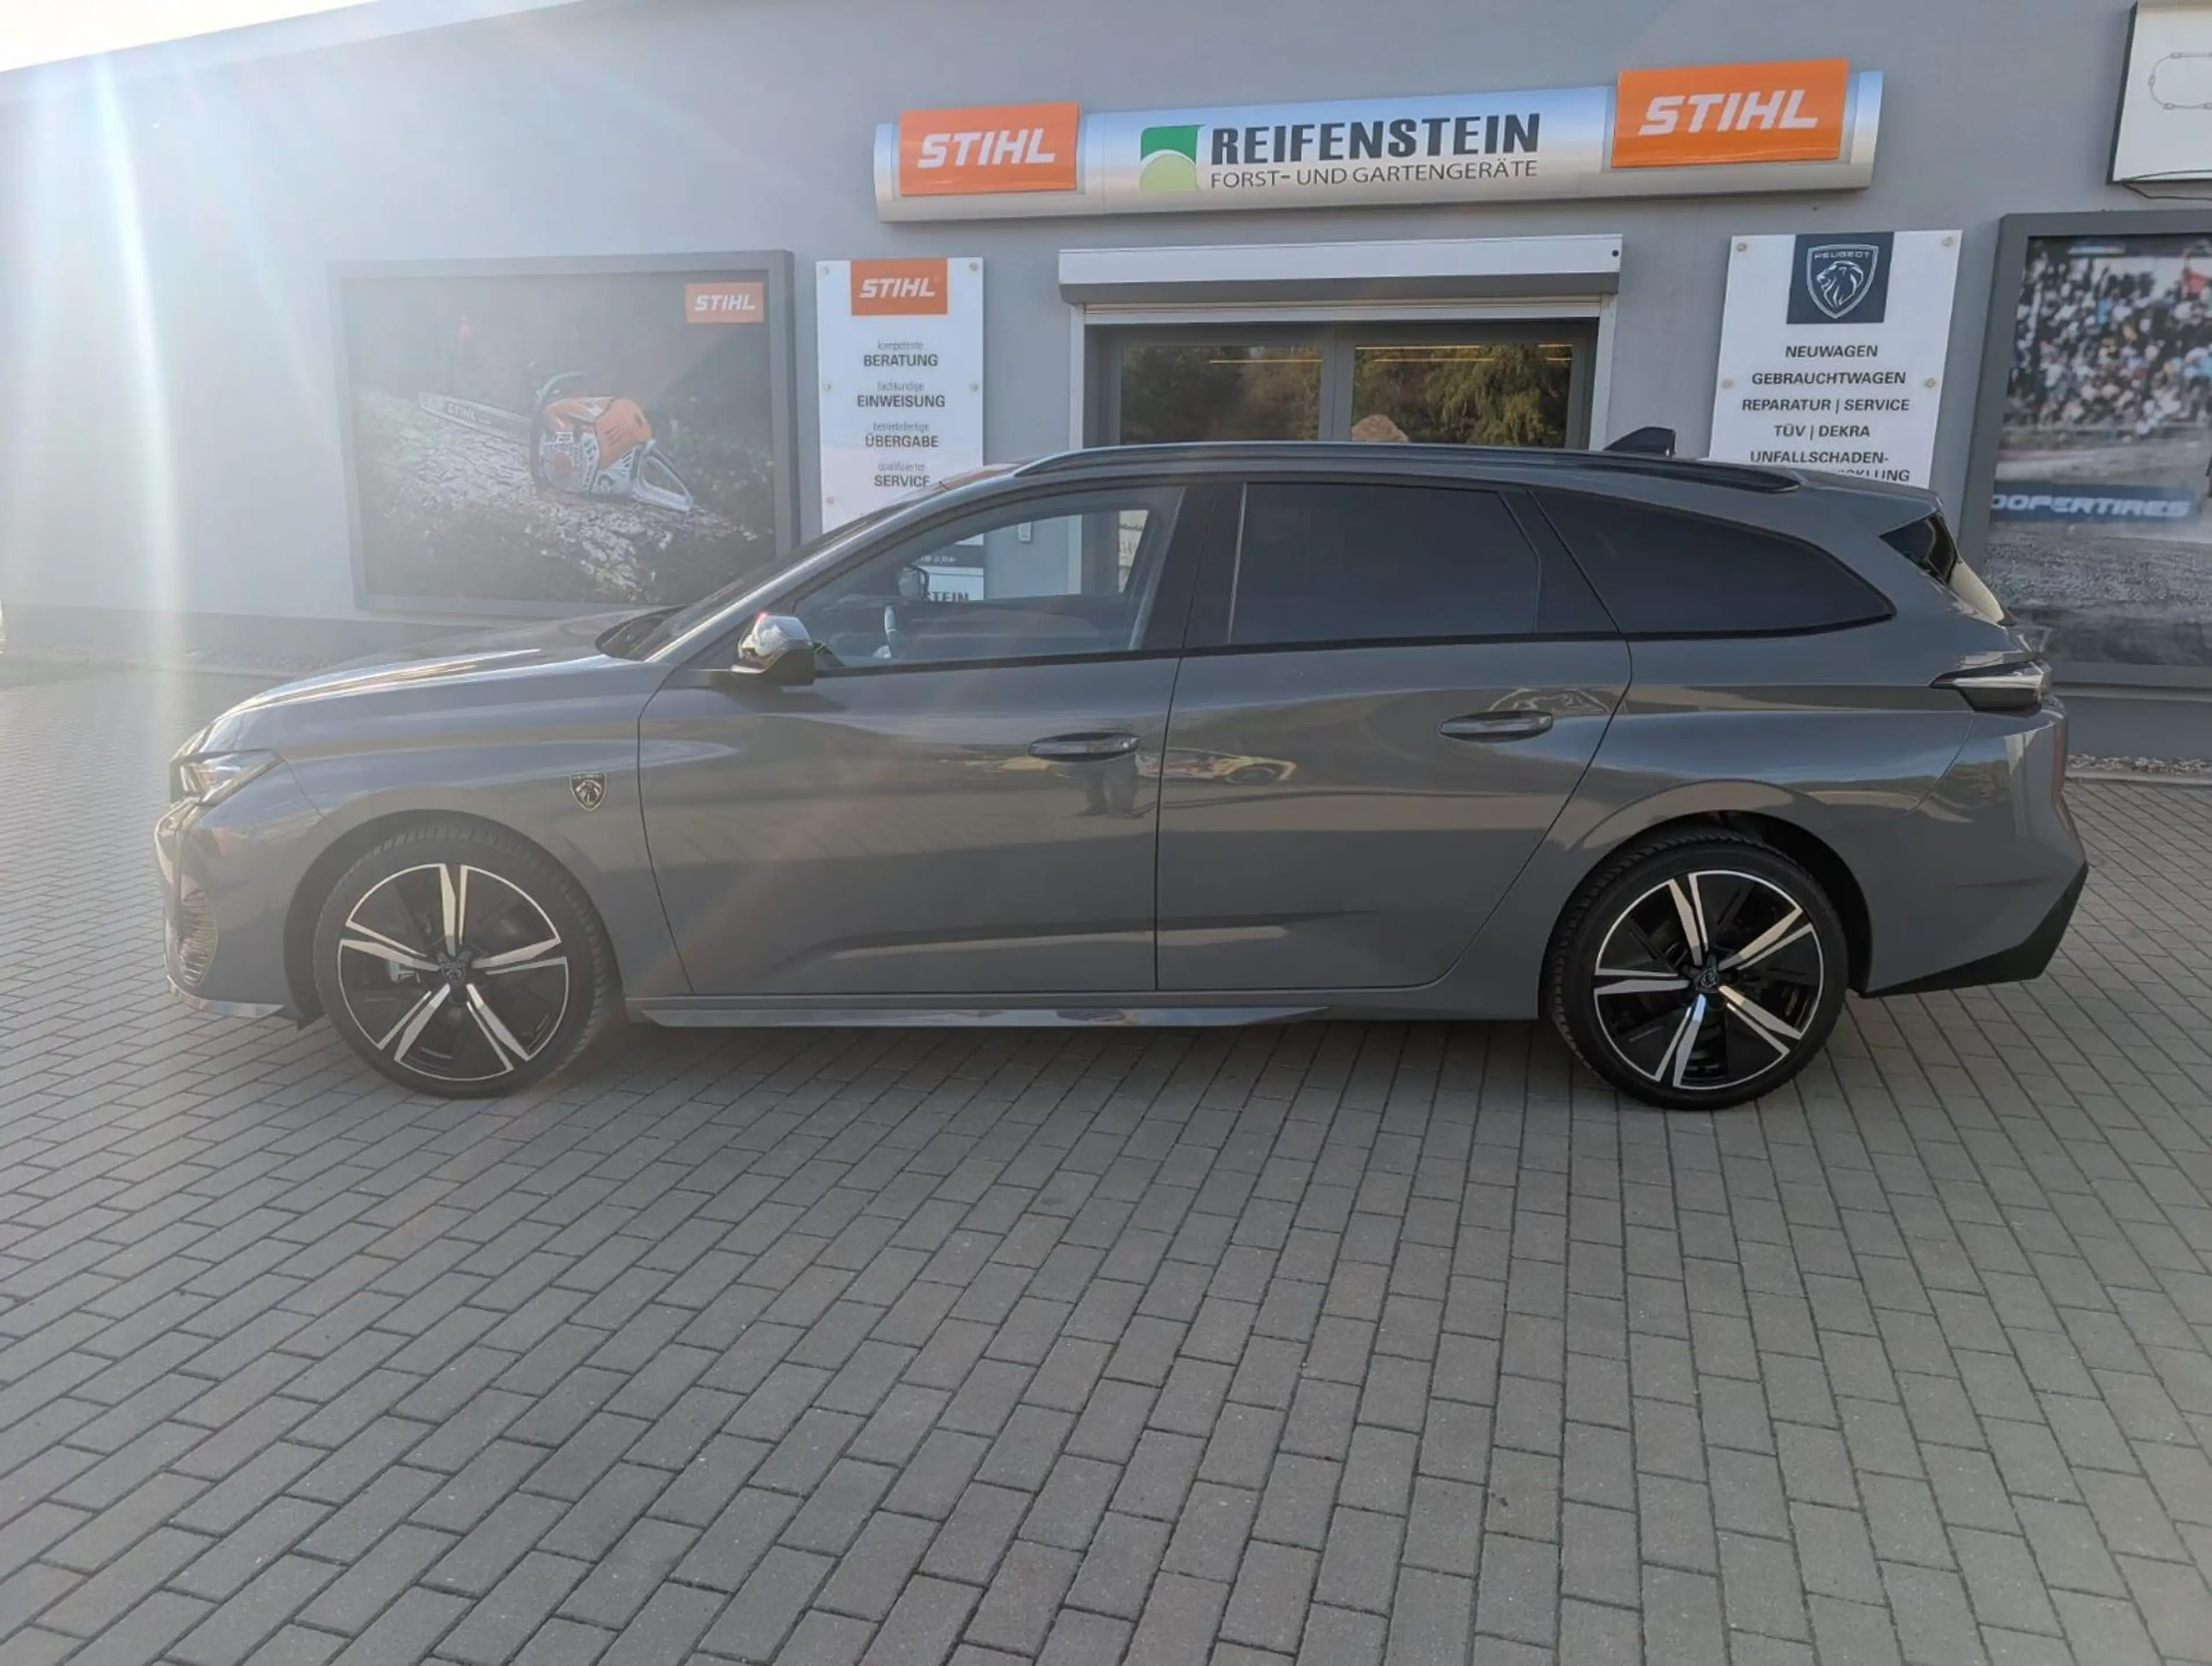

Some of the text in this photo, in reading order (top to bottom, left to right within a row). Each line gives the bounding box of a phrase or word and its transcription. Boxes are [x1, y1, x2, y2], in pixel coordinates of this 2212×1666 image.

[1639, 89, 1818, 136] STIHL
[1210, 112, 1540, 165] REIFENSTEIN
[917, 127, 1057, 169] STIHL
[1210, 157, 1538, 189] FORST- UND GARTENGERÄTE
[1813, 250, 1870, 259] PEUGEOT
[859, 277, 936, 298] STIHL
[694, 294, 756, 312] STIHL
[1784, 345, 1878, 358] NEUWAGEN
[863, 353, 938, 367] BERATUNG
[1751, 371, 1906, 385] GEBRAUCHTWAGEN
[856, 395, 945, 408] EINWEISUNG
[1742, 399, 1832, 411] REPARATUR
[1843, 399, 1911, 411] SERVICE
[1774, 423, 1807, 437] TÜV
[1818, 425, 1871, 438] DEKRA
[864, 432, 940, 448] ÜBERGABE
[1750, 450, 1889, 464] UNFALLSCHADEN-
